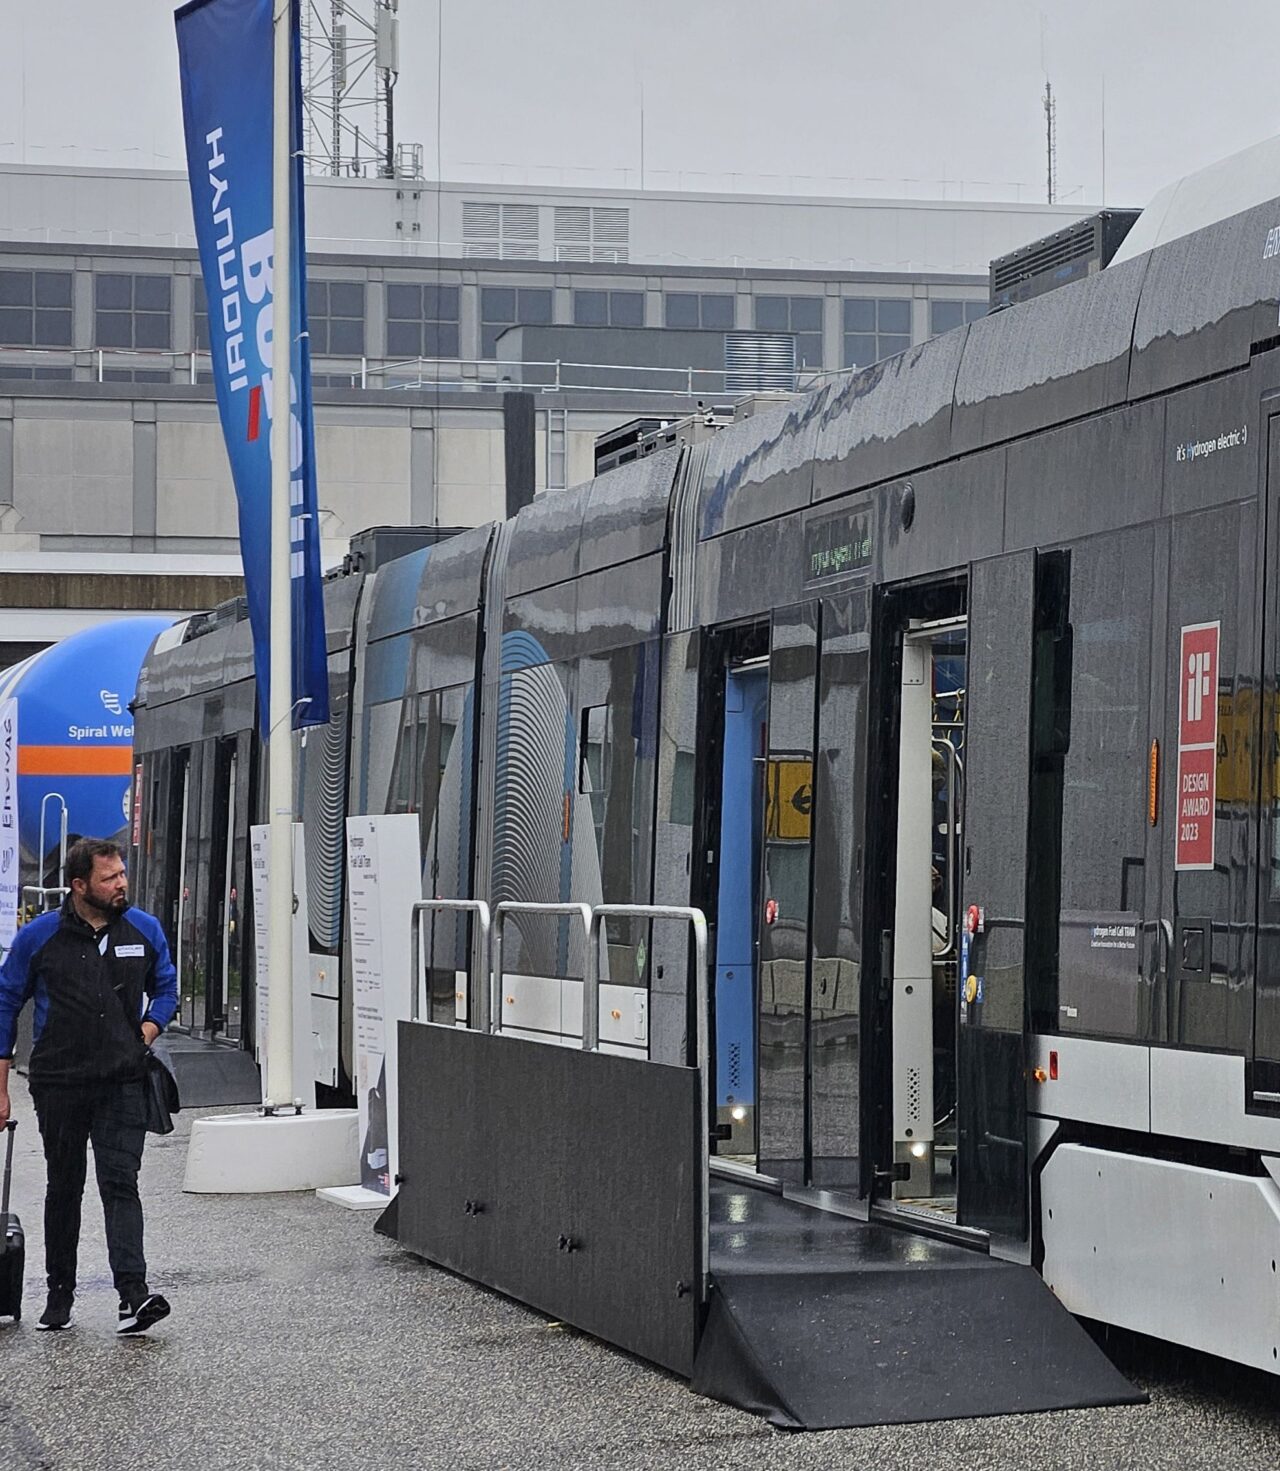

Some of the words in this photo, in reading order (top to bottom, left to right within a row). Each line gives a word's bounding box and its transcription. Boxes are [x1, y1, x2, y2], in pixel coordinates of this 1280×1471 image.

[1176, 443, 1186, 461] it's
[1187, 441, 1217, 461] Hydrogen
[1218, 428, 1241, 450] electric
[68, 725, 107, 741] Spiral
[1183, 772, 1209, 793] DESIGN
[1181, 797, 1210, 817] AWARD
[1180, 823, 1199, 841] 2023
